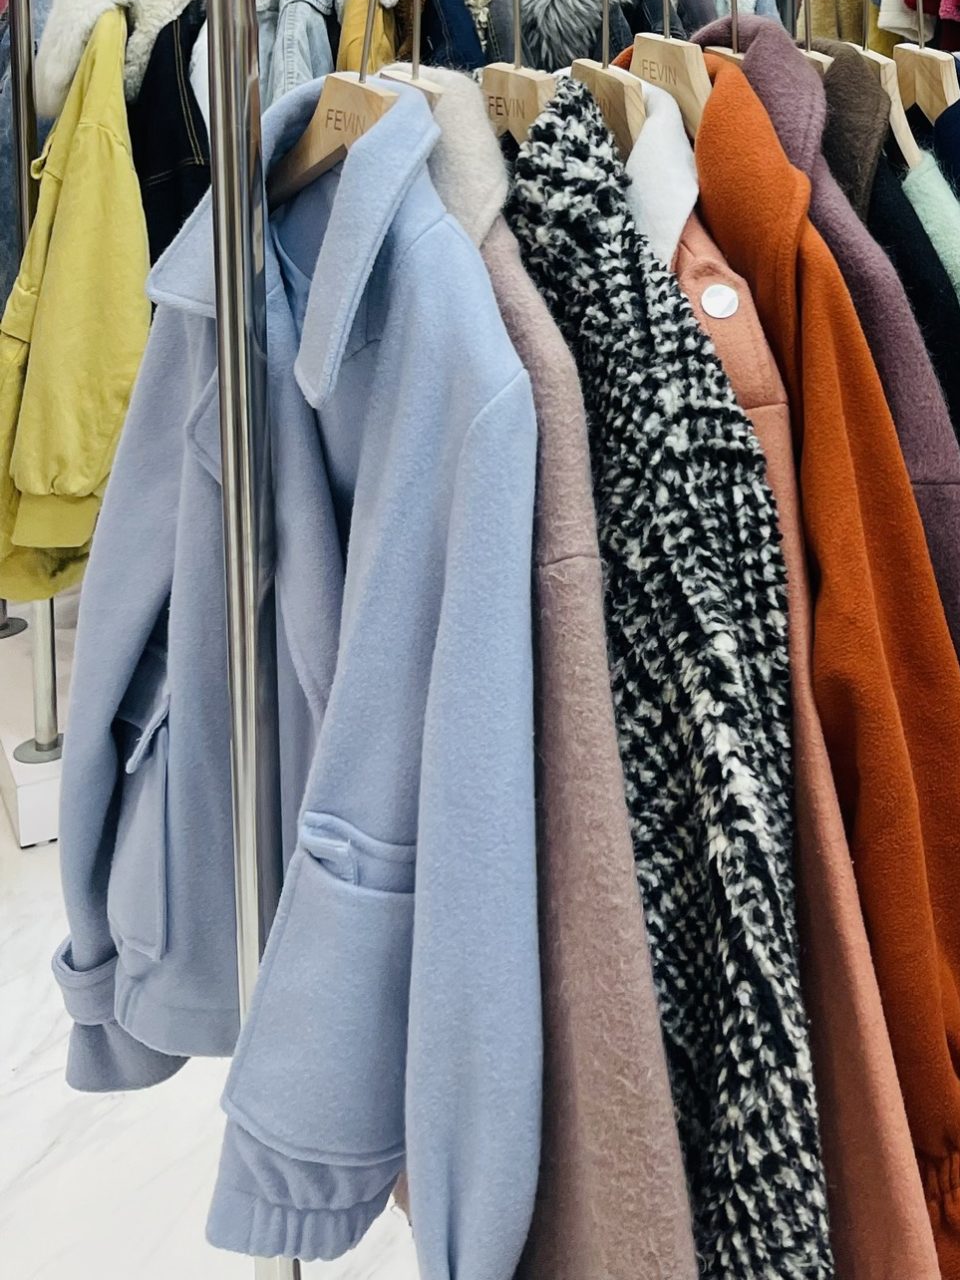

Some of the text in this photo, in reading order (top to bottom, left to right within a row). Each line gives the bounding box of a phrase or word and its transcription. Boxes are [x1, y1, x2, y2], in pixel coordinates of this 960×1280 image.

[642, 59, 677, 85] FEVIN
[488, 96, 525, 119] FEVIN
[325, 109, 366, 136] FEVIN
